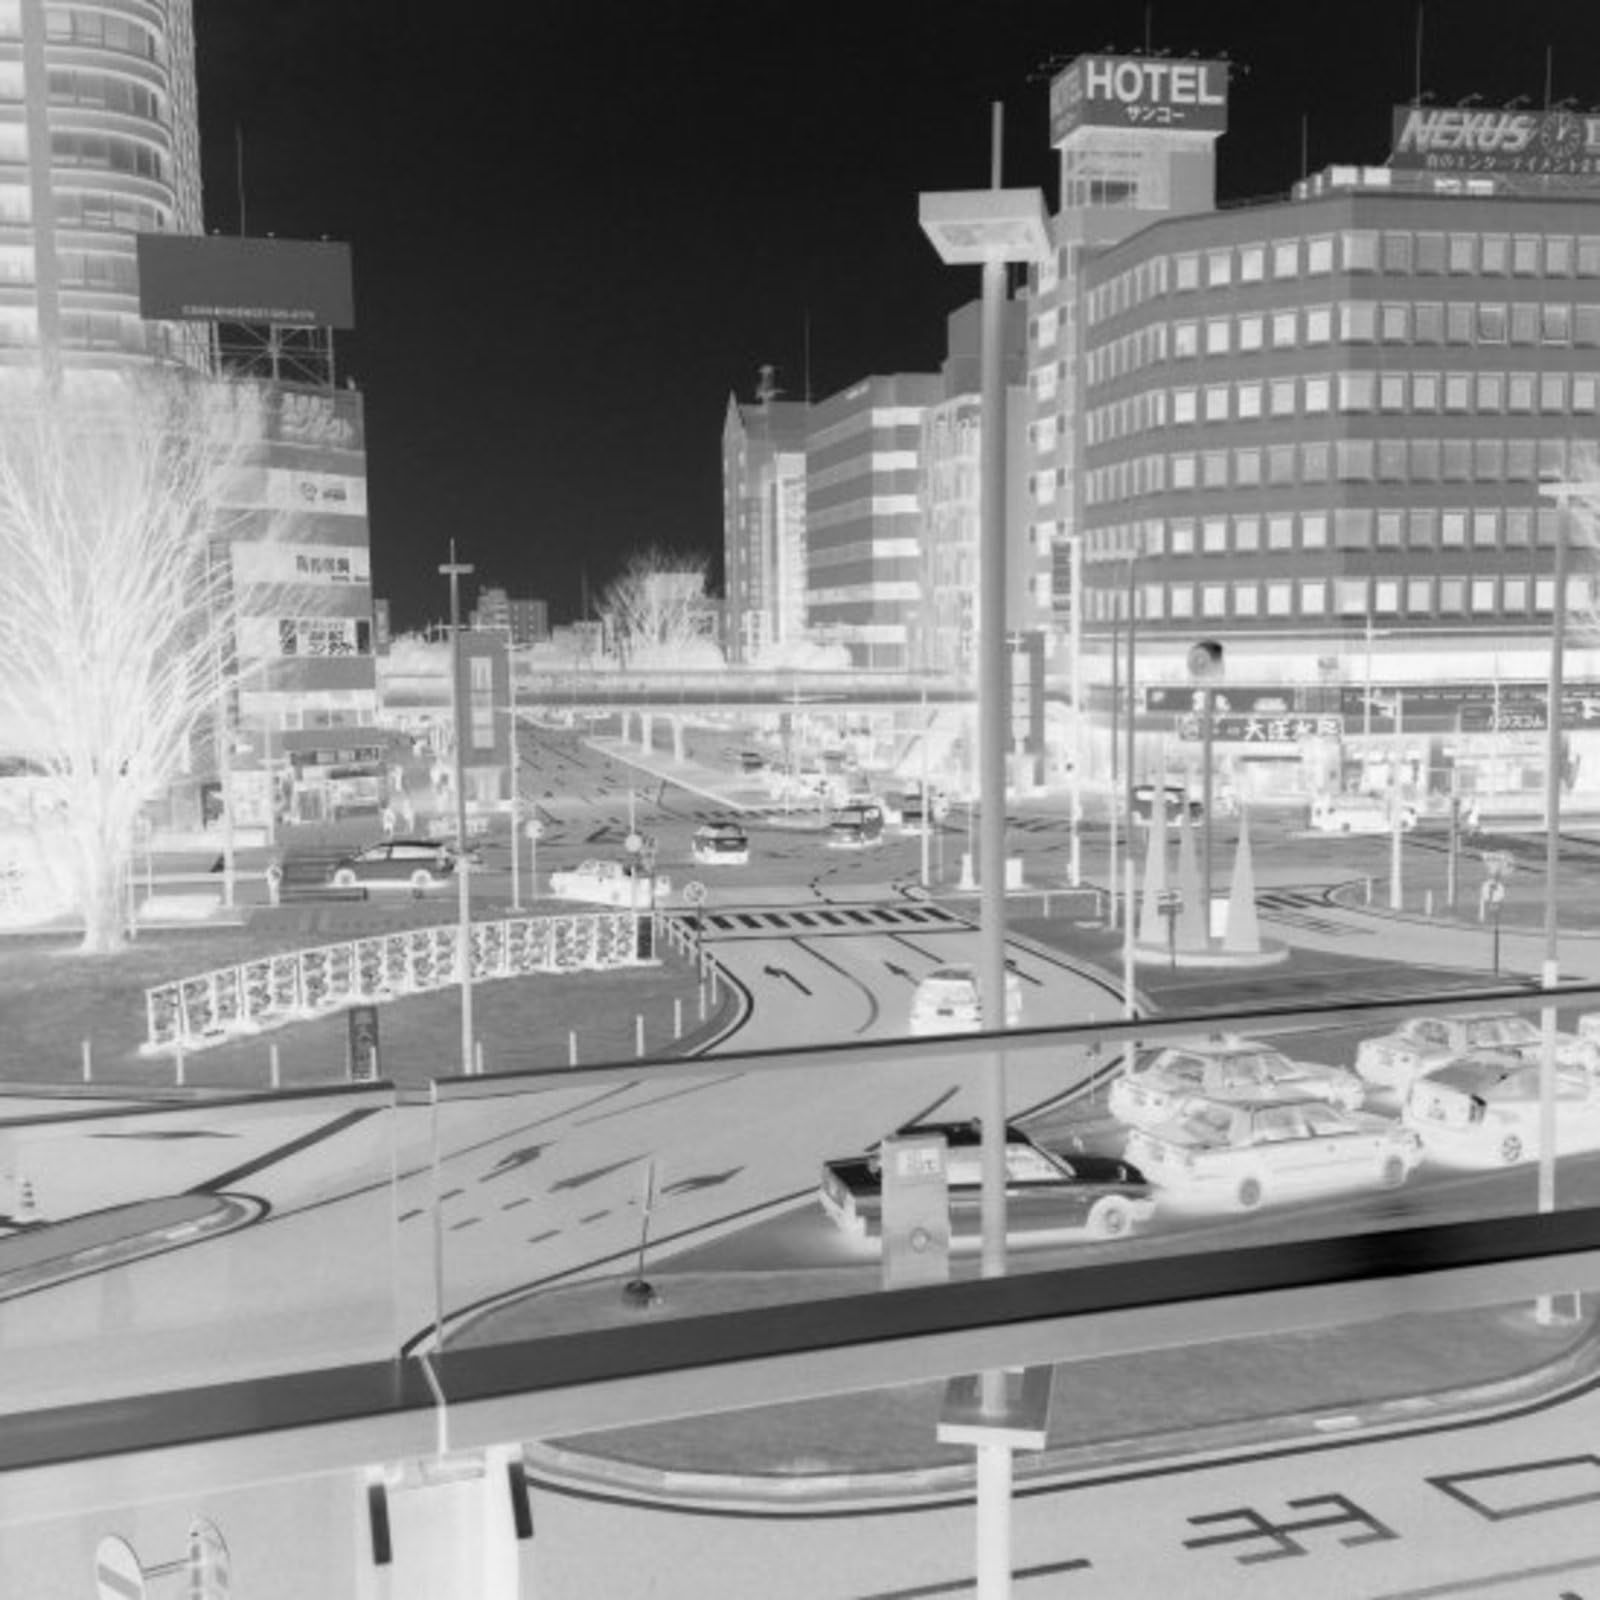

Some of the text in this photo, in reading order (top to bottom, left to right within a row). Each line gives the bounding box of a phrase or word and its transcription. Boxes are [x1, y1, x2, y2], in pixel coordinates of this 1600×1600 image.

[1086, 60, 1225, 105] HOTEL
[1126, 106, 1185, 122] サンコー
[1399, 110, 1536, 151] NEXUS
